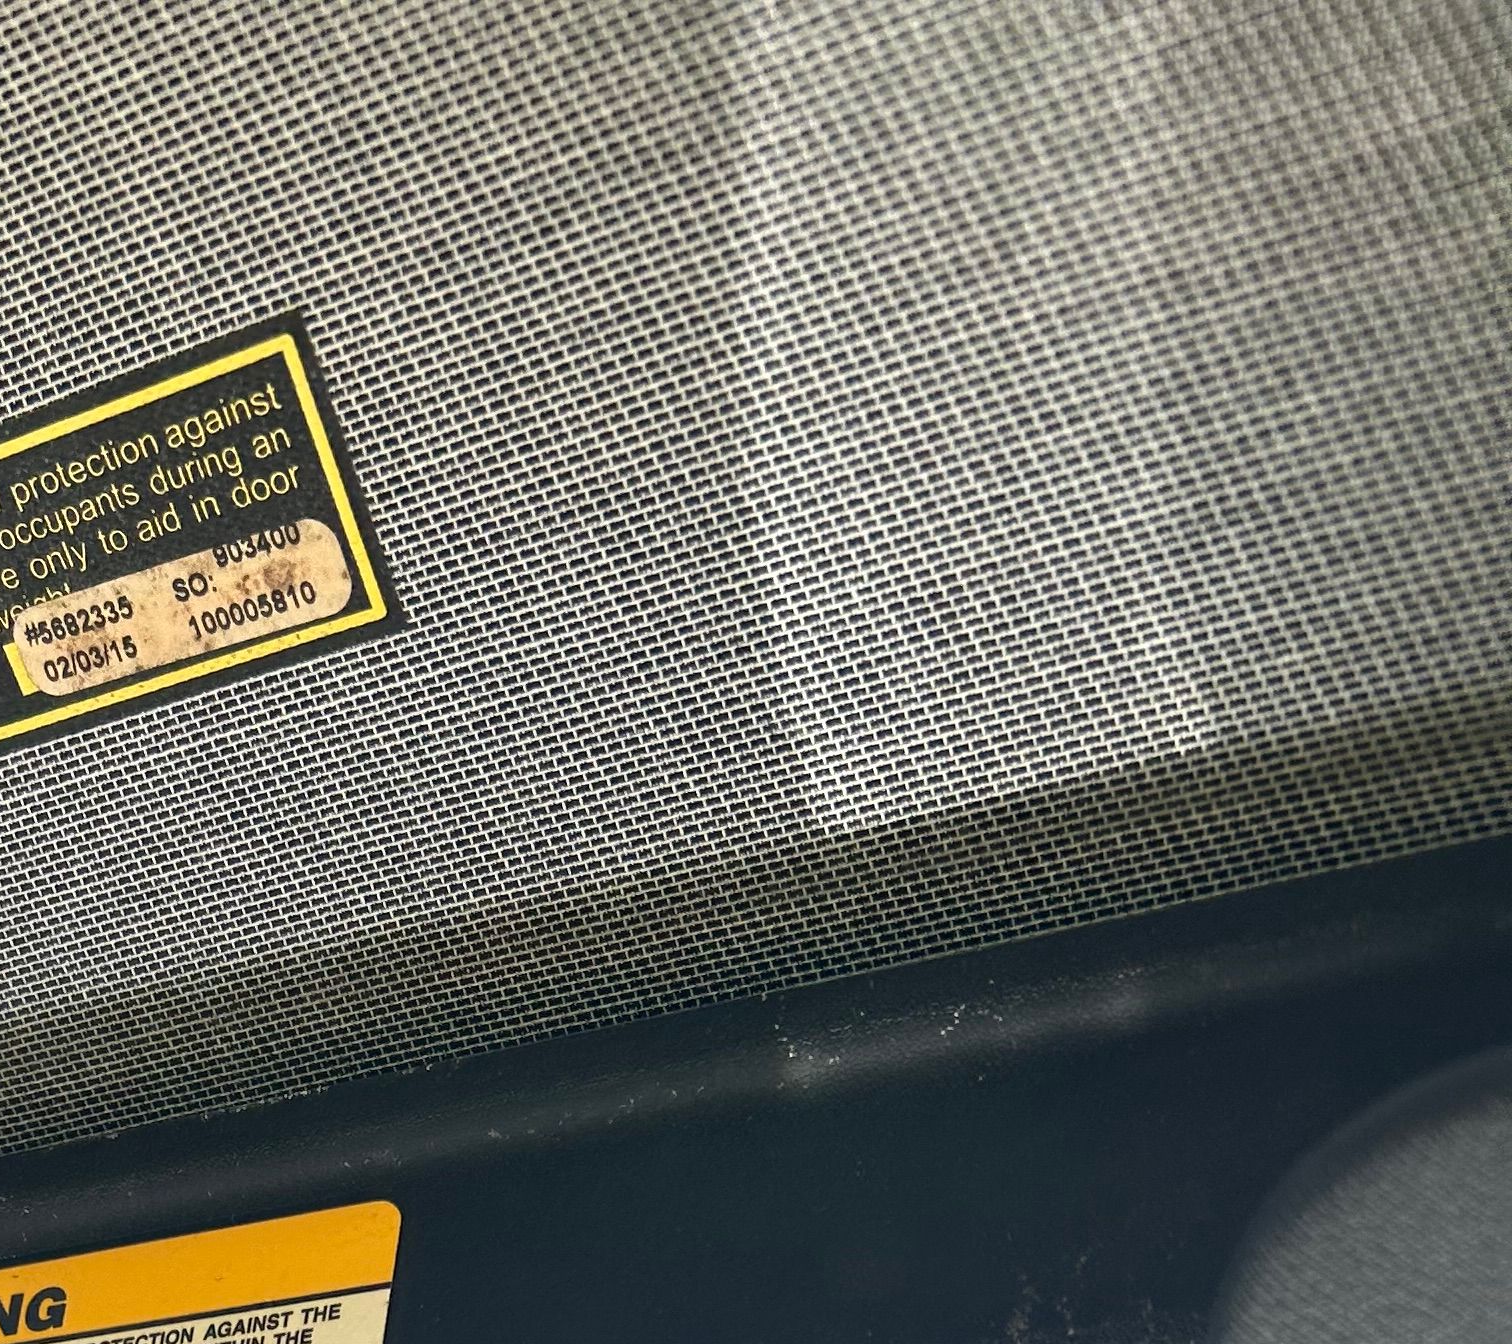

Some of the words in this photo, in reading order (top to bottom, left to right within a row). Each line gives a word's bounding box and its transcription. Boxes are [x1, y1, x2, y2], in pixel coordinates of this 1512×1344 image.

[10, 432, 160, 510] protection
[165, 382, 282, 449] against
[149, 444, 243, 496] during
[251, 427, 292, 459] an
[30, 541, 87, 579] only
[97, 528, 128, 555] to
[136, 502, 181, 543] aid
[190, 493, 221, 523] in
[230, 463, 300, 509] door
[213, 523, 300, 567] 903400
[24, 596, 133, 646] #5682335
[172, 572, 217, 602] SO:
[44, 635, 137, 682] 02/03/15
[189, 581, 316, 640] 100005810
[203, 1310, 294, 1341] AGAINST
[300, 1303, 342, 1324] THE
